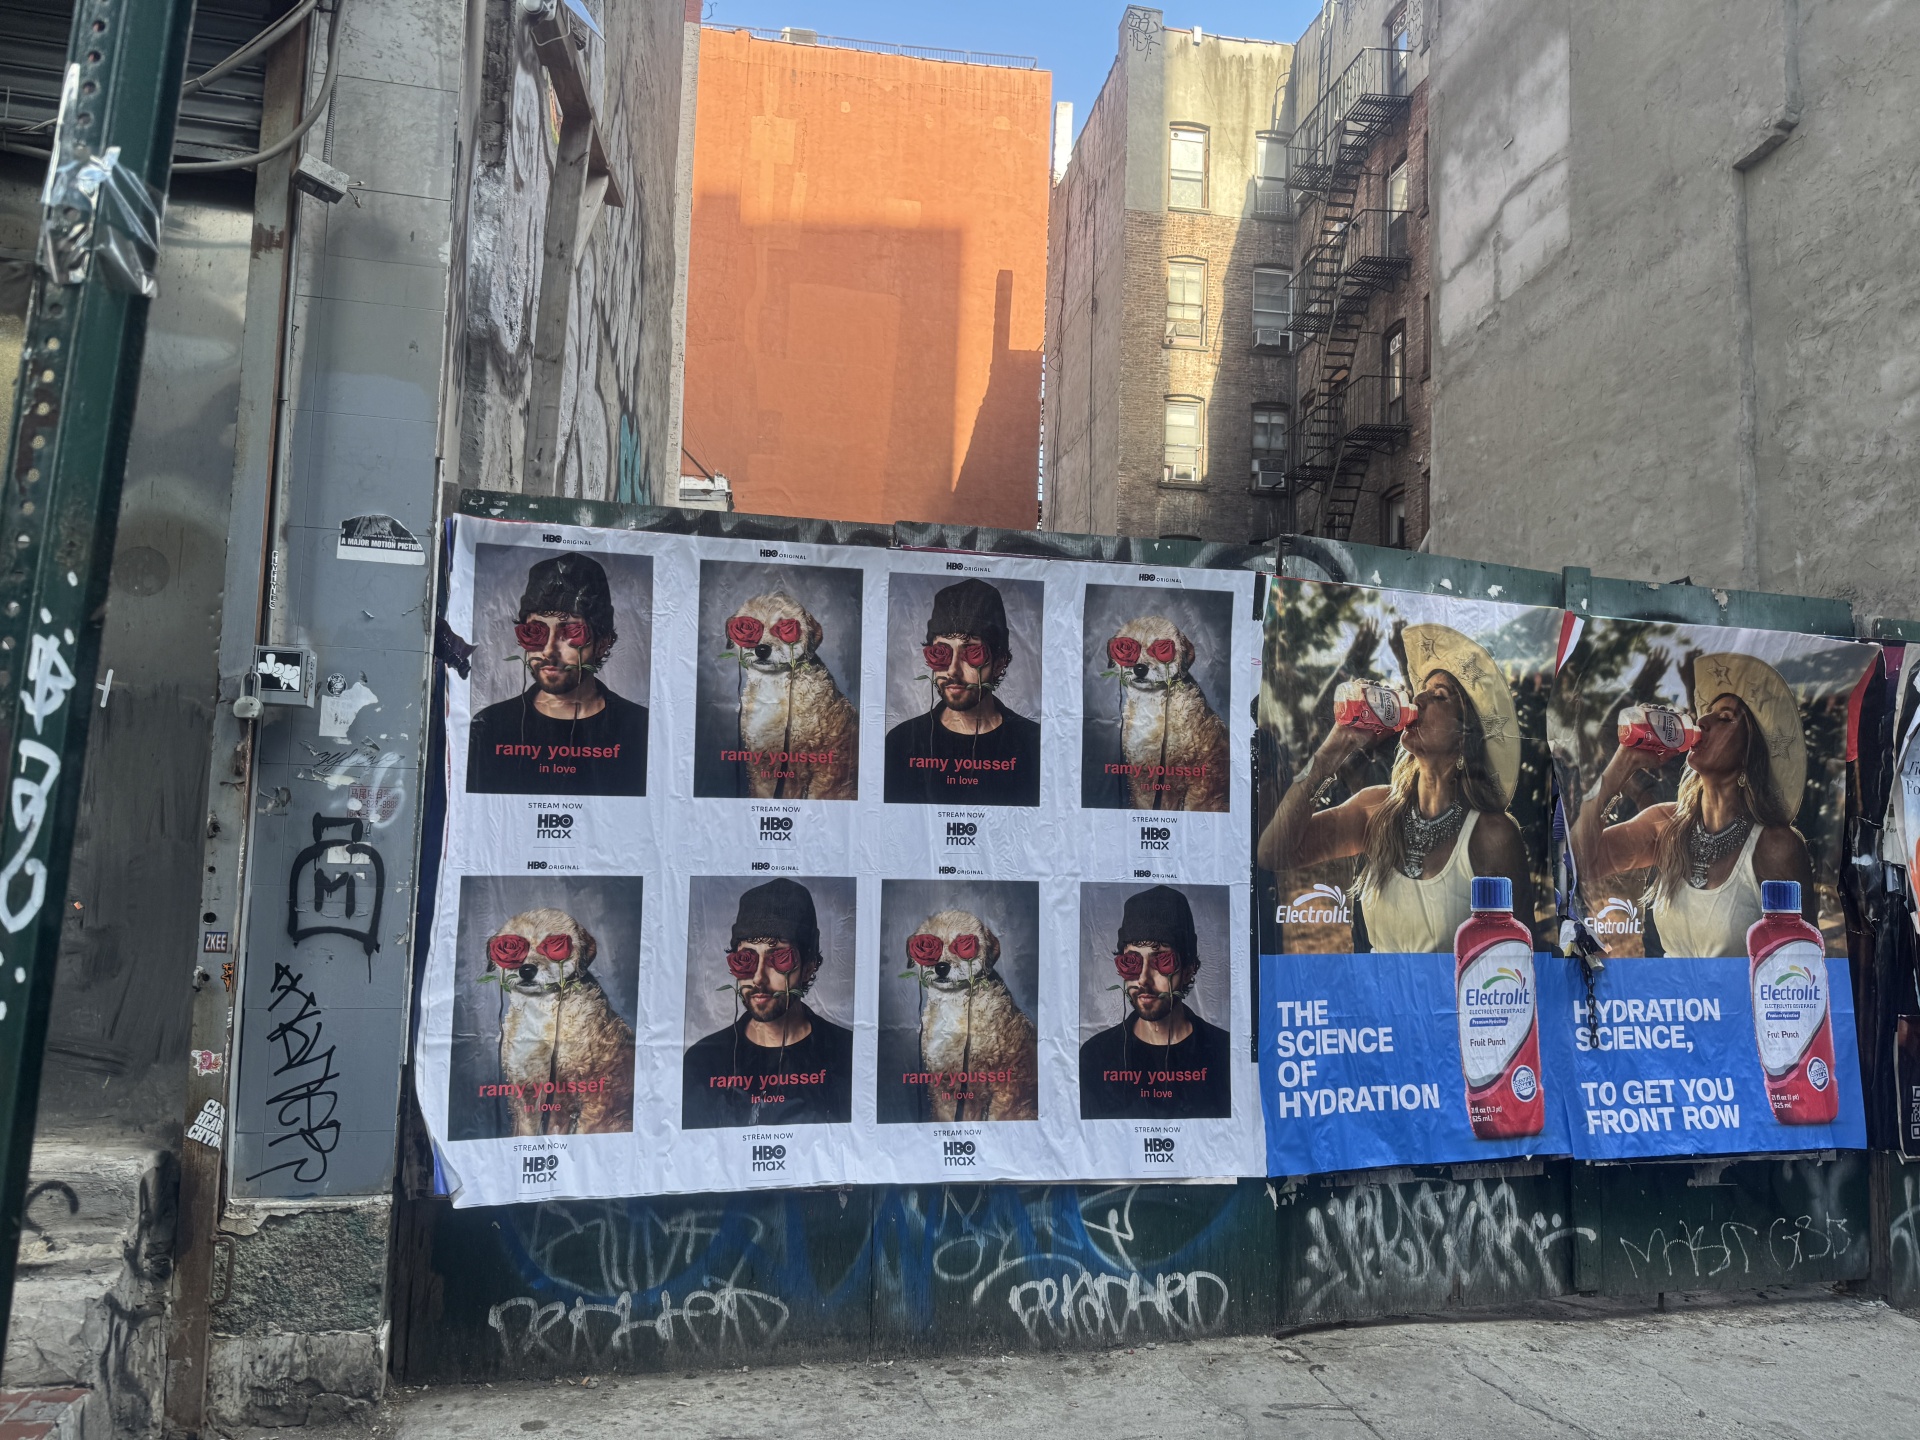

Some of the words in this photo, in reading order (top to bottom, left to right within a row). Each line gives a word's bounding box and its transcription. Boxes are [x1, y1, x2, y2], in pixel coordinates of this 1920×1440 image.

[347, 538, 369, 546] MAJOR
[371, 540, 396, 548] MOTION
[543, 534, 562, 543] HBO
[760, 549, 778, 557] HBO
[946, 562, 963, 570] HBO
[496, 744, 541, 760] ramy
[549, 744, 620, 760] youssef
[721, 749, 763, 764] ramy
[769, 750, 834, 764] youssef
[539, 765, 550, 773] in
[553, 765, 576, 773] love
[910, 758, 948, 772] ramy
[955, 758, 1016, 772] youssef
[1105, 762, 1142, 776] ramy
[1148, 764, 1207, 777] youssef
[761, 769, 771, 778] in
[773, 769, 794, 779] love
[1141, 782, 1149, 790] in
[1152, 782, 1171, 791] love
[538, 814, 573, 828] HBO
[760, 817, 793, 830] HBO
[537, 829, 571, 838] max
[760, 832, 791, 841] max
[947, 823, 977, 836] HBO
[1141, 827, 1170, 840] HBO
[947, 837, 975, 845] max
[1141, 838, 1169, 850] max
[528, 861, 547, 869] HBO
[752, 862, 770, 870] HBO
[1276, 906, 1350, 923] Electrolit
[205, 934, 226, 950] ZKEE
[1466, 988, 1530, 1006] Electrolit
[1760, 985, 1821, 1000] Electrolit
[1277, 1000, 1328, 1027] THE
[1574, 998, 1720, 1023] HYDRATION
[1278, 1027, 1393, 1057] SCIENCE
[1470, 1038, 1486, 1047] Fruit
[1488, 1037, 1506, 1046] Punch
[1576, 1025, 1693, 1053] SCIENCE,
[710, 1076, 753, 1090] ramy
[760, 1070, 826, 1090] youssef
[903, 1070, 942, 1086] ramy
[950, 1069, 1013, 1085] youssef
[1104, 1071, 1142, 1085] ramy
[1148, 1068, 1207, 1084] youssef
[1278, 1060, 1317, 1087] OF
[479, 1080, 526, 1098] ramy
[533, 1077, 606, 1095] youssef
[1153, 1090, 1172, 1098] love
[1581, 1082, 1616, 1106] TO
[1623, 1080, 1675, 1104] GET
[1679, 1078, 1734, 1102] YOU
[752, 1095, 760, 1103] in
[941, 1091, 950, 1100] in
[954, 1090, 974, 1100] love
[1279, 1081, 1440, 1118] HYDRATION
[524, 1103, 535, 1112] in
[538, 1101, 561, 1112] love
[1586, 1107, 1675, 1134] FRONT
[1682, 1105, 1739, 1130] ROW
[548, 1142, 567, 1150] NOW
[944, 1141, 975, 1155] HBO
[1144, 1138, 1174, 1152] HBO
[753, 1145, 786, 1160] HBO
[1145, 1153, 1174, 1162] max
[523, 1155, 558, 1174] HBO
[753, 1161, 785, 1171] max
[945, 1157, 975, 1166] max
[523, 1169, 556, 1183] max
